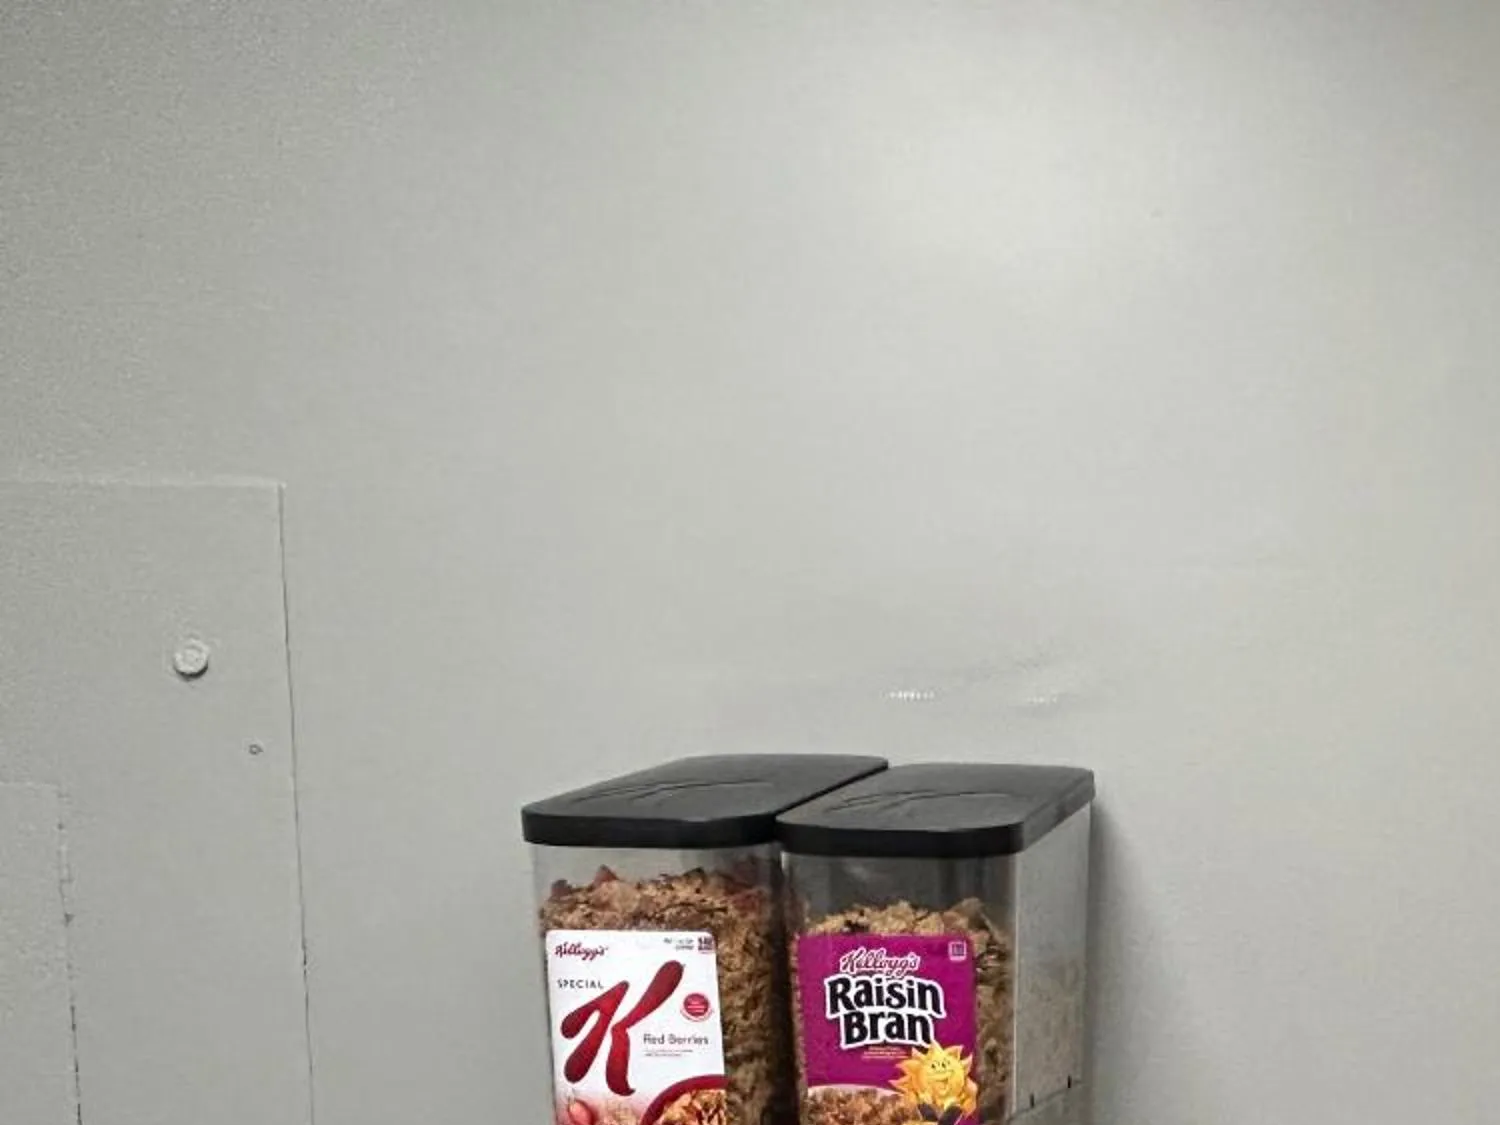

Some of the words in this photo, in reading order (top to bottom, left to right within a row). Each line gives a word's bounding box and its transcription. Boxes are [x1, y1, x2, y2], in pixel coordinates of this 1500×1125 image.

[841, 948, 919, 979] Kellogg's
[557, 979, 603, 989] SPECIAL
[827, 977, 942, 1015] Raisin
[561, 960, 684, 1096] K
[643, 1033, 665, 1044] Red
[668, 1033, 709, 1045] Berries
[843, 1011, 931, 1044] Bran
